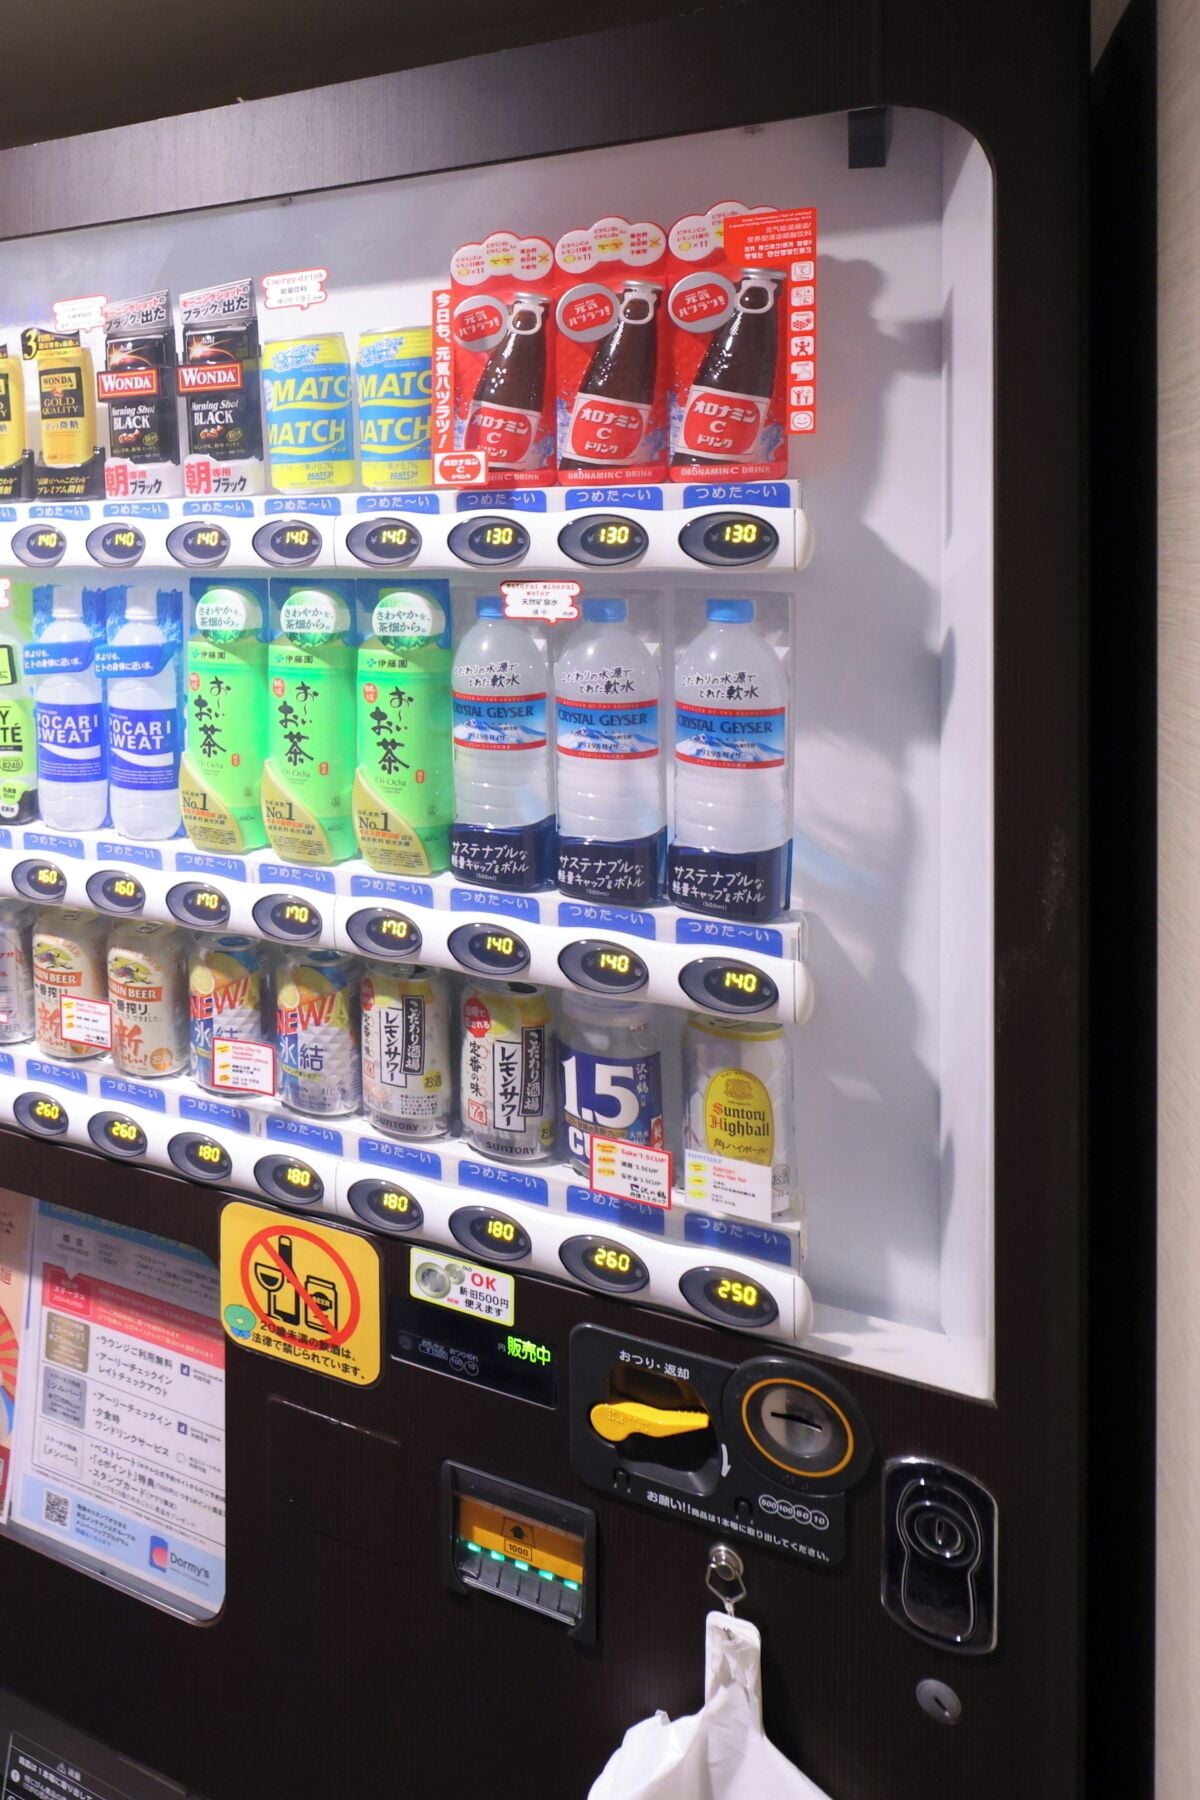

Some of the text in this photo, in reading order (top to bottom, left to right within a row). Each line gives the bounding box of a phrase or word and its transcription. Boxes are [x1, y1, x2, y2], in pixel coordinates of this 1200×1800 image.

[42, 375, 73, 386] WONDA
[101, 374, 152, 392] WONDA
[181, 367, 236, 386] WONDA
[272, 375, 352, 402] MATC
[44, 396, 75, 407] GOLD
[219, 399, 239, 409] Shot
[194, 410, 234, 425] BLACK
[581, 407, 641, 429] オロナミン
[693, 401, 757, 423] オロナミン
[113, 415, 150, 430] BLACK
[472, 414, 529, 435] オロナミン
[486, 432, 502, 444] C
[596, 428, 612, 440] C
[105, 464, 129, 497] 朝
[185, 461, 212, 494] 朝
[114, 532, 135, 546] 140
[196, 531, 218, 546] 140
[285, 530, 309, 545] 140
[485, 527, 513, 545] 130
[598, 526, 629, 543] 130
[724, 524, 757, 543] 130
[200, 651, 226, 660] 伊藤園
[285, 655, 314, 665] 伊藤園
[486, 705, 534, 719] GEYSER
[599, 711, 647, 726] GEYSER
[720, 719, 774, 735] GEYSER
[358, 812, 392, 833] No.1
[452, 841, 528, 860] サステナブルな
[559, 855, 644, 875] サステナブルな
[674, 865, 764, 890] サステナブルな
[114, 881, 134, 895] 160
[196, 894, 218, 909] 170
[285, 907, 308, 922] 170
[382, 921, 407, 937] 170
[50, 973, 76, 984] BEER
[189, 976, 250, 1020] NEW!
[275, 991, 336, 1036] NEW!
[279, 1037, 324, 1072] 氷結
[384, 1011, 400, 1082] レモンサワー
[424, 1072, 442, 1089] お酒
[498, 1047, 520, 1127] レモンサワー
[561, 1055, 640, 1129] 1.5
[712, 1102, 766, 1122] Suntory
[111, 1122, 136, 1140] 260
[375, 1115, 419, 1131] SUNTORY
[710, 1114, 770, 1138] Highball
[198, 1145, 220, 1162] 180
[486, 1140, 536, 1155] SUNTORY
[287, 1168, 311, 1186] 180
[383, 1193, 408, 1212] 180
[594, 1248, 630, 1271] 260
[471, 1272, 497, 1292] OK
[717, 1281, 757, 1305] 250
[464, 1298, 503, 1317] 使えます
[259, 1319, 357, 1362] 20歳未満の飲酒は、
[252, 1333, 366, 1380] 法律で禁じられています。
[507, 1335, 551, 1366] 販売中
[619, 1349, 690, 1380] おつり・返却
[98, 1365, 169, 1398] レイトチェックアウト
[94, 1419, 170, 1457] ワンドリンクサービス
[778, 1504, 793, 1516] 100
[814, 1515, 825, 1526] 10
[507, 1543, 530, 1559] 1000
[169, 1552, 211, 1580] Dormy's
